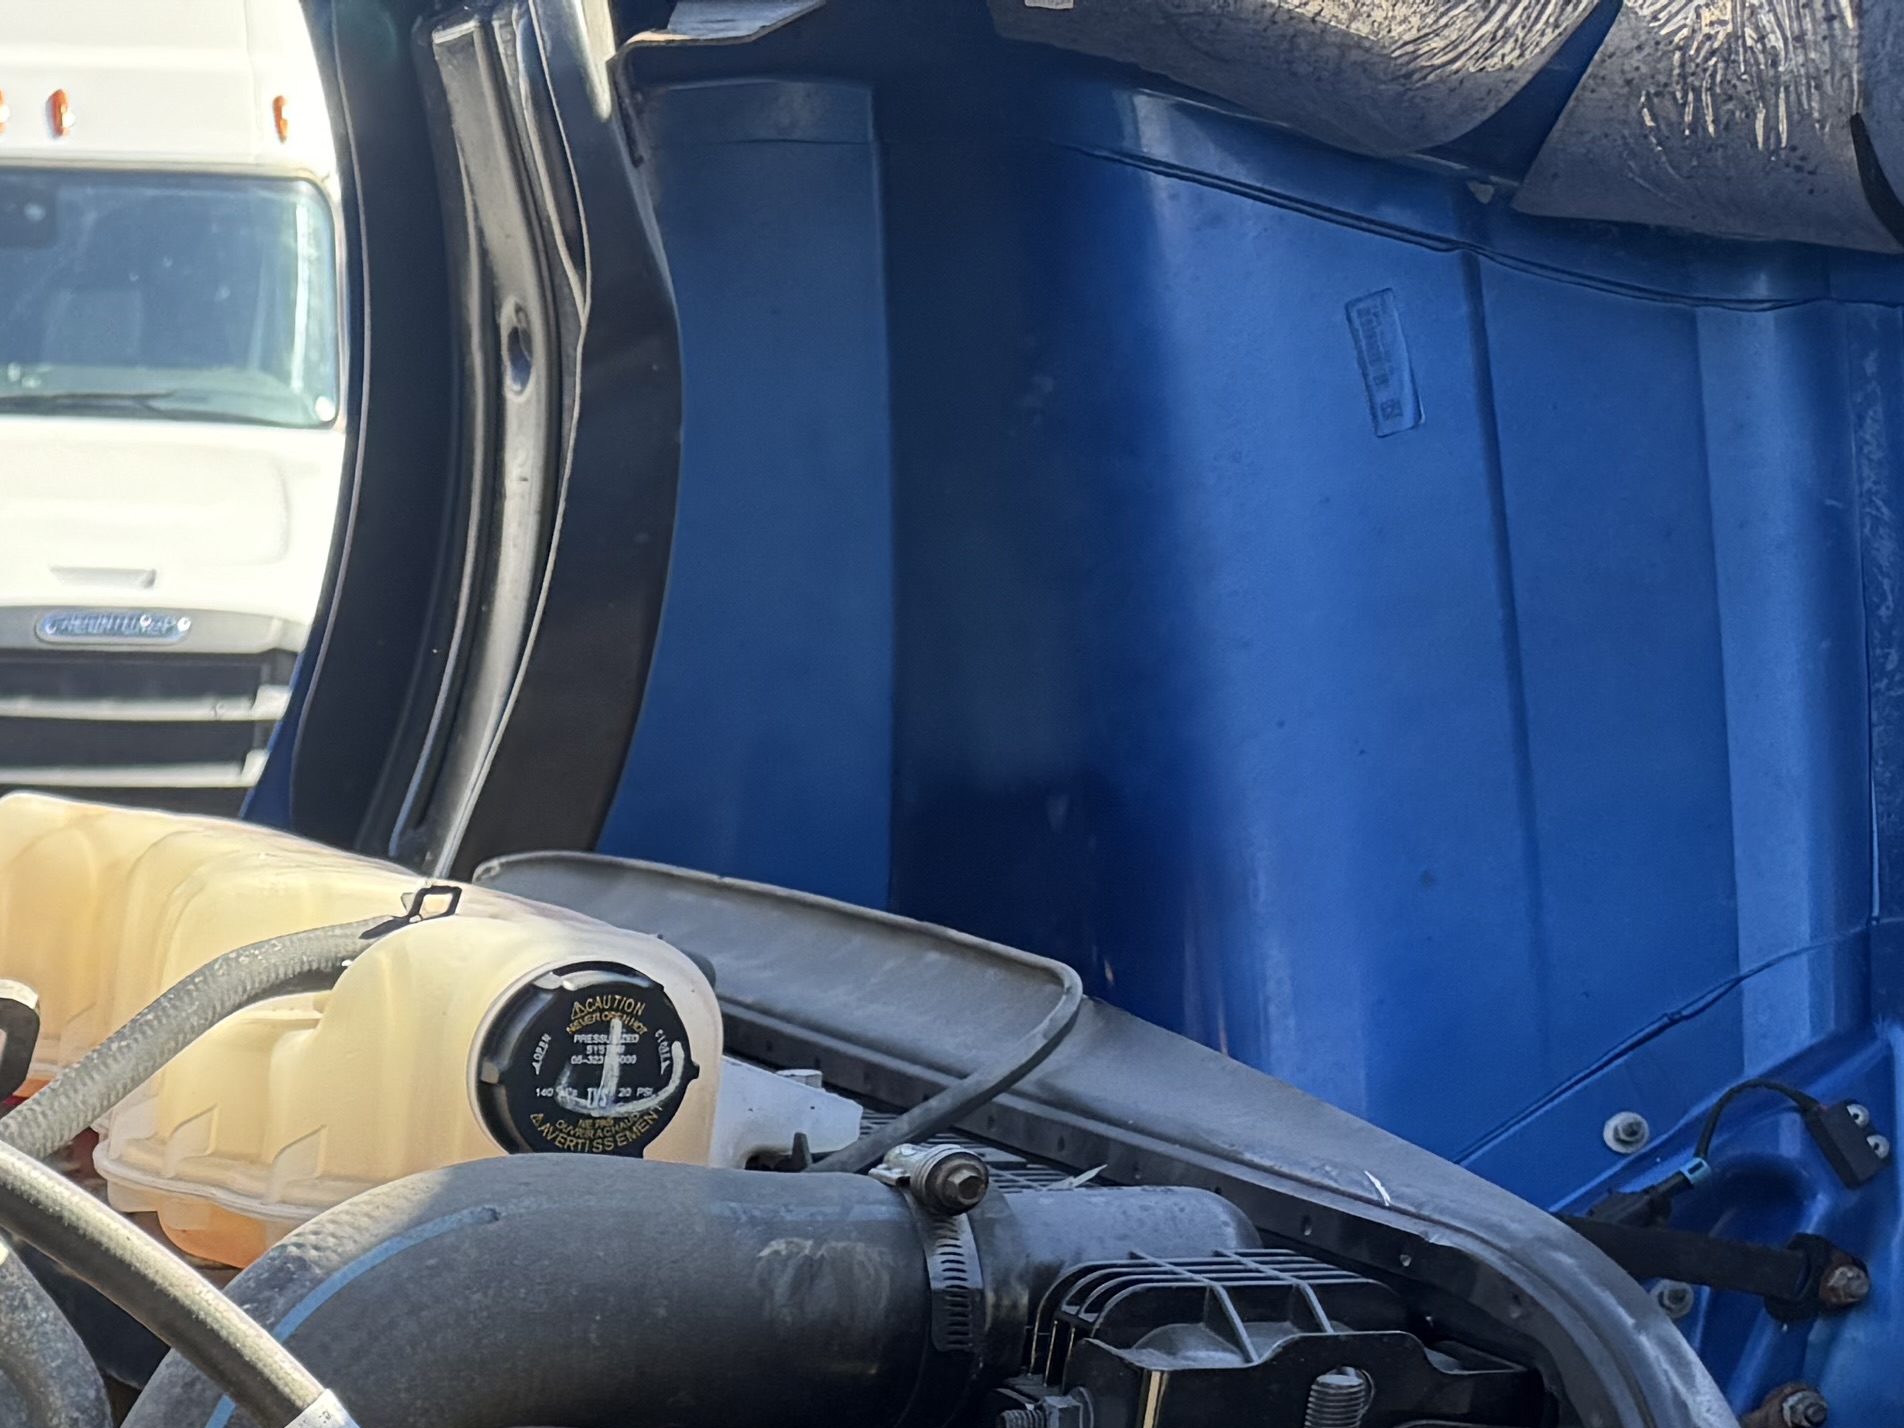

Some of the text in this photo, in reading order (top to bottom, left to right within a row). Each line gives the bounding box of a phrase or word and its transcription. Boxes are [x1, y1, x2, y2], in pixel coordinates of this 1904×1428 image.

[586, 994, 646, 1016] CAUTION
[566, 1012, 602, 1034] NEVER
[618, 1088, 632, 1097] 20
[538, 1105, 663, 1153] AVERTISSEMENT
